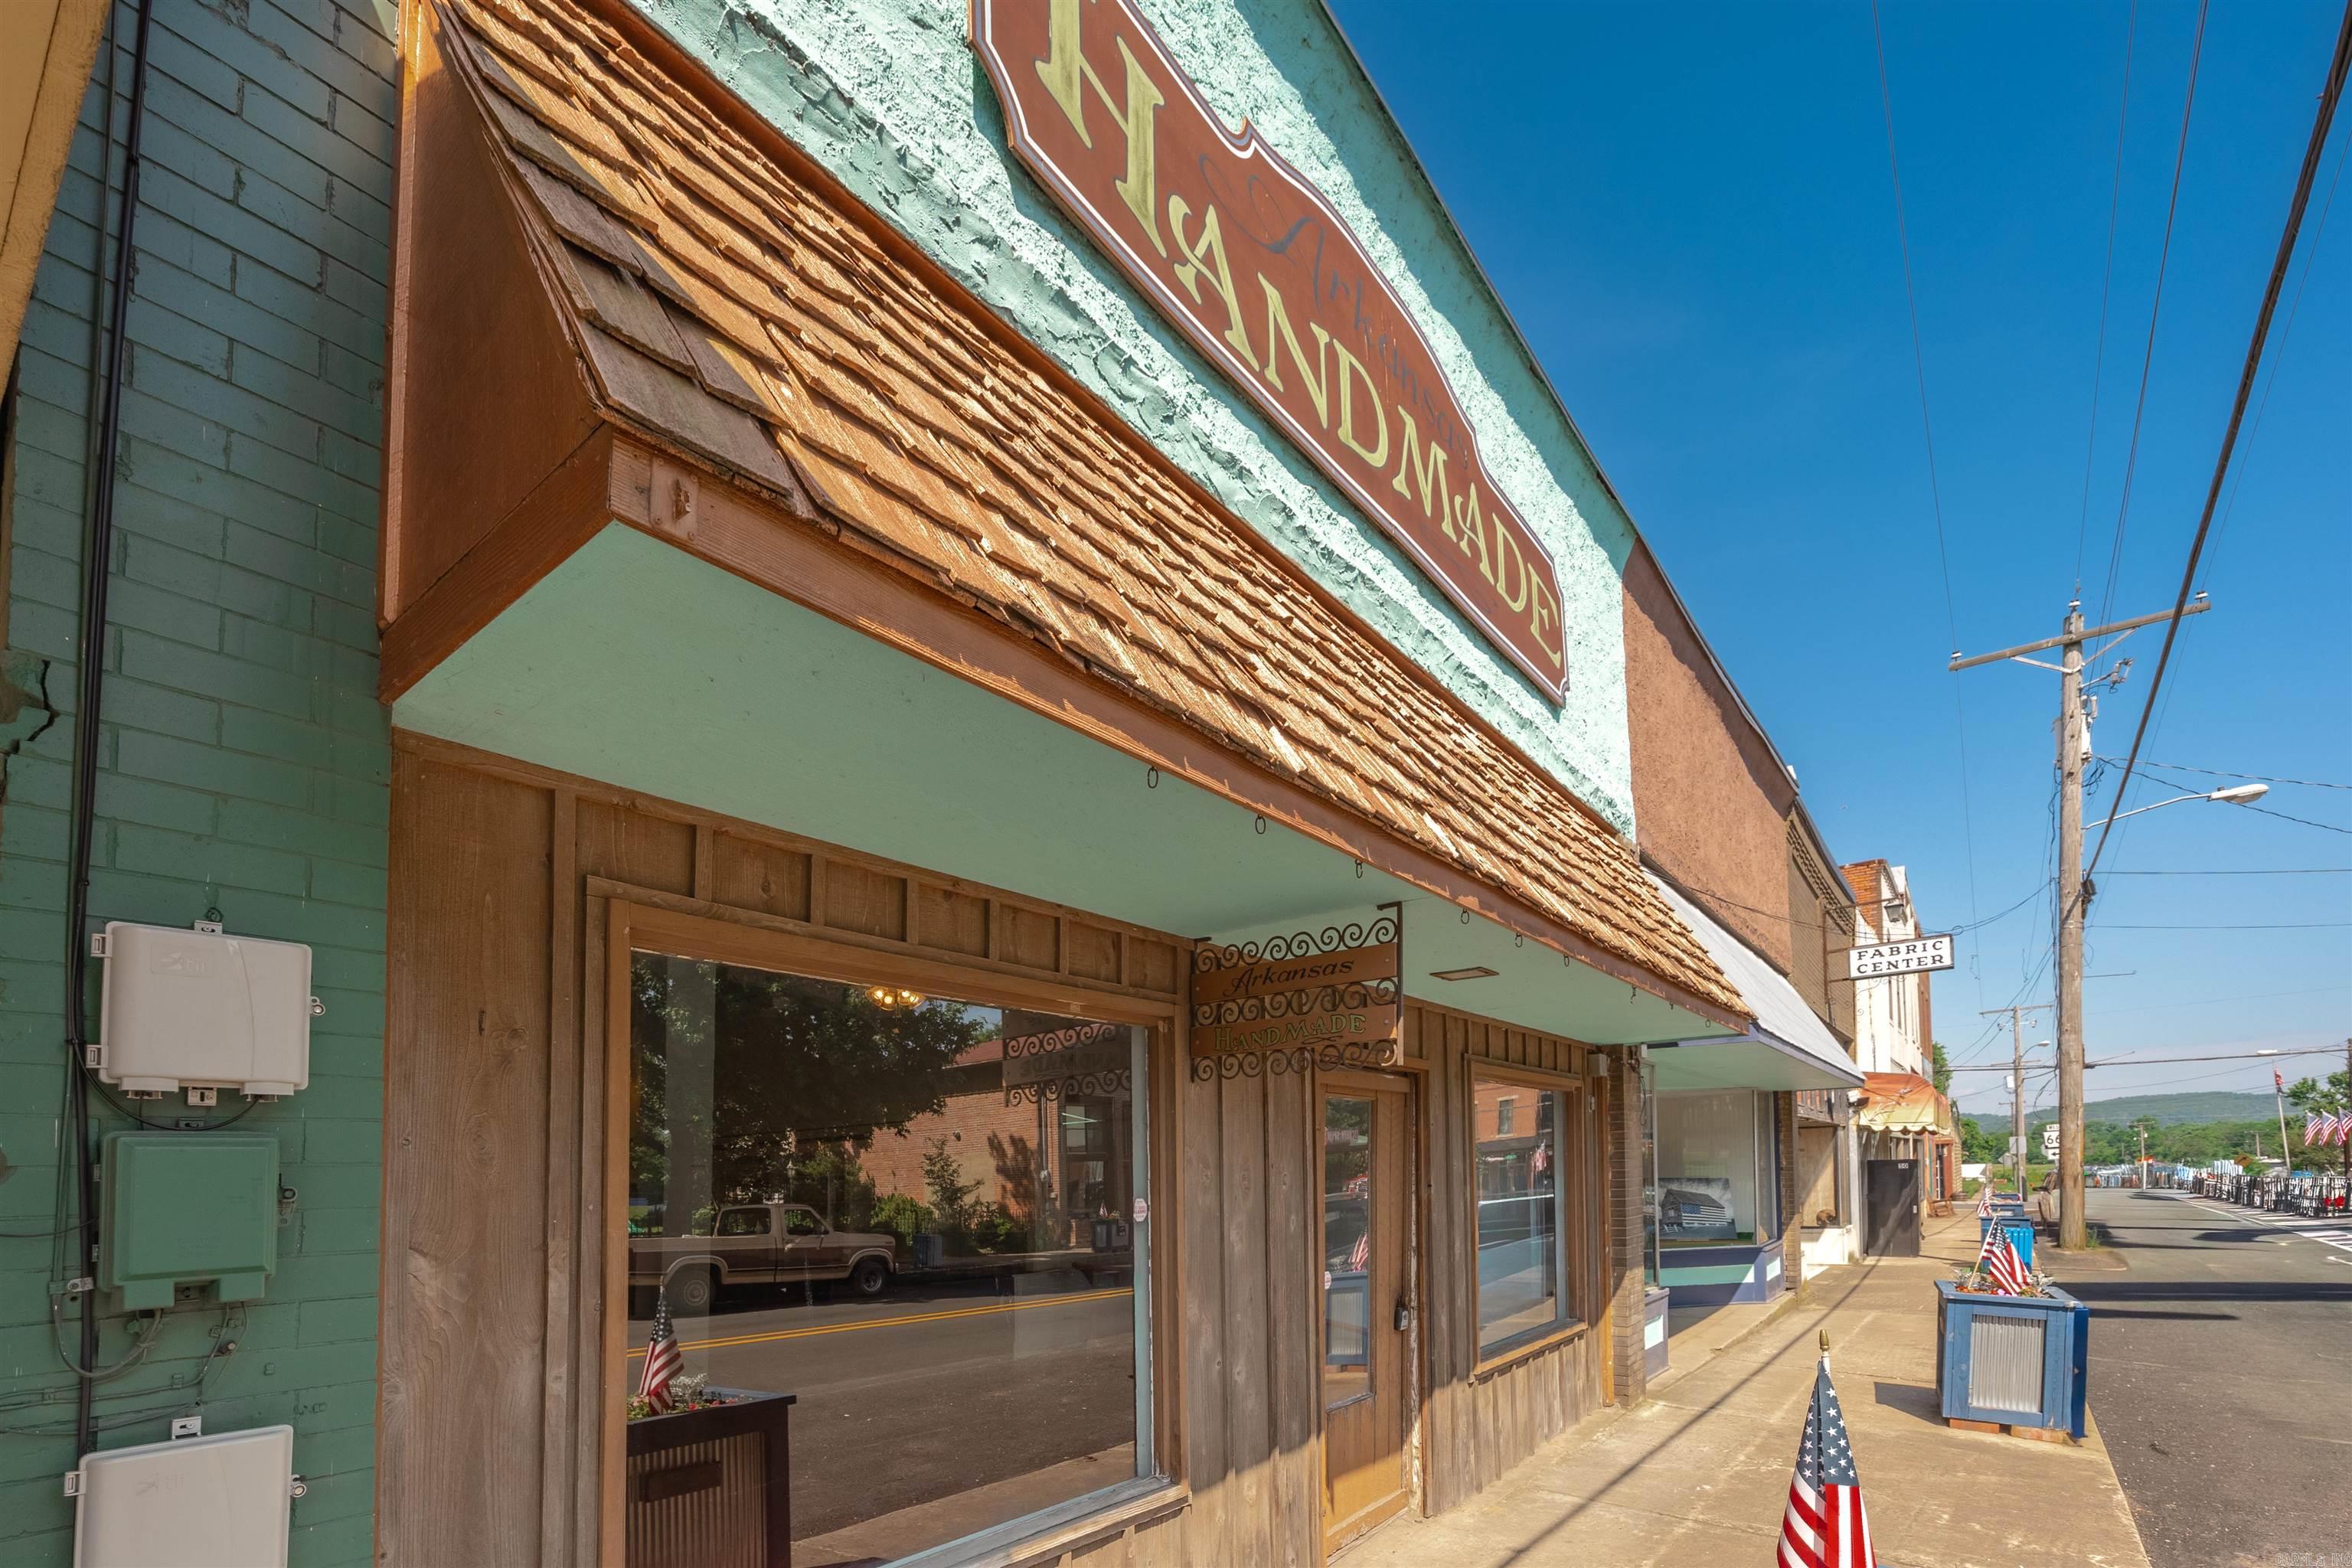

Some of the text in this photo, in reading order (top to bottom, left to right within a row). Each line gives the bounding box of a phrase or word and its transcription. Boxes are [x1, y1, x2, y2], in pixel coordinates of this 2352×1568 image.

[1035, 0, 1562, 669] HANDMADE
[1857, 940, 1943, 961] FABRIC
[1857, 954, 1945, 974] CENTER
[1223, 959, 1354, 997] Arkansas
[1214, 1014, 1367, 1052] HANDMADE
